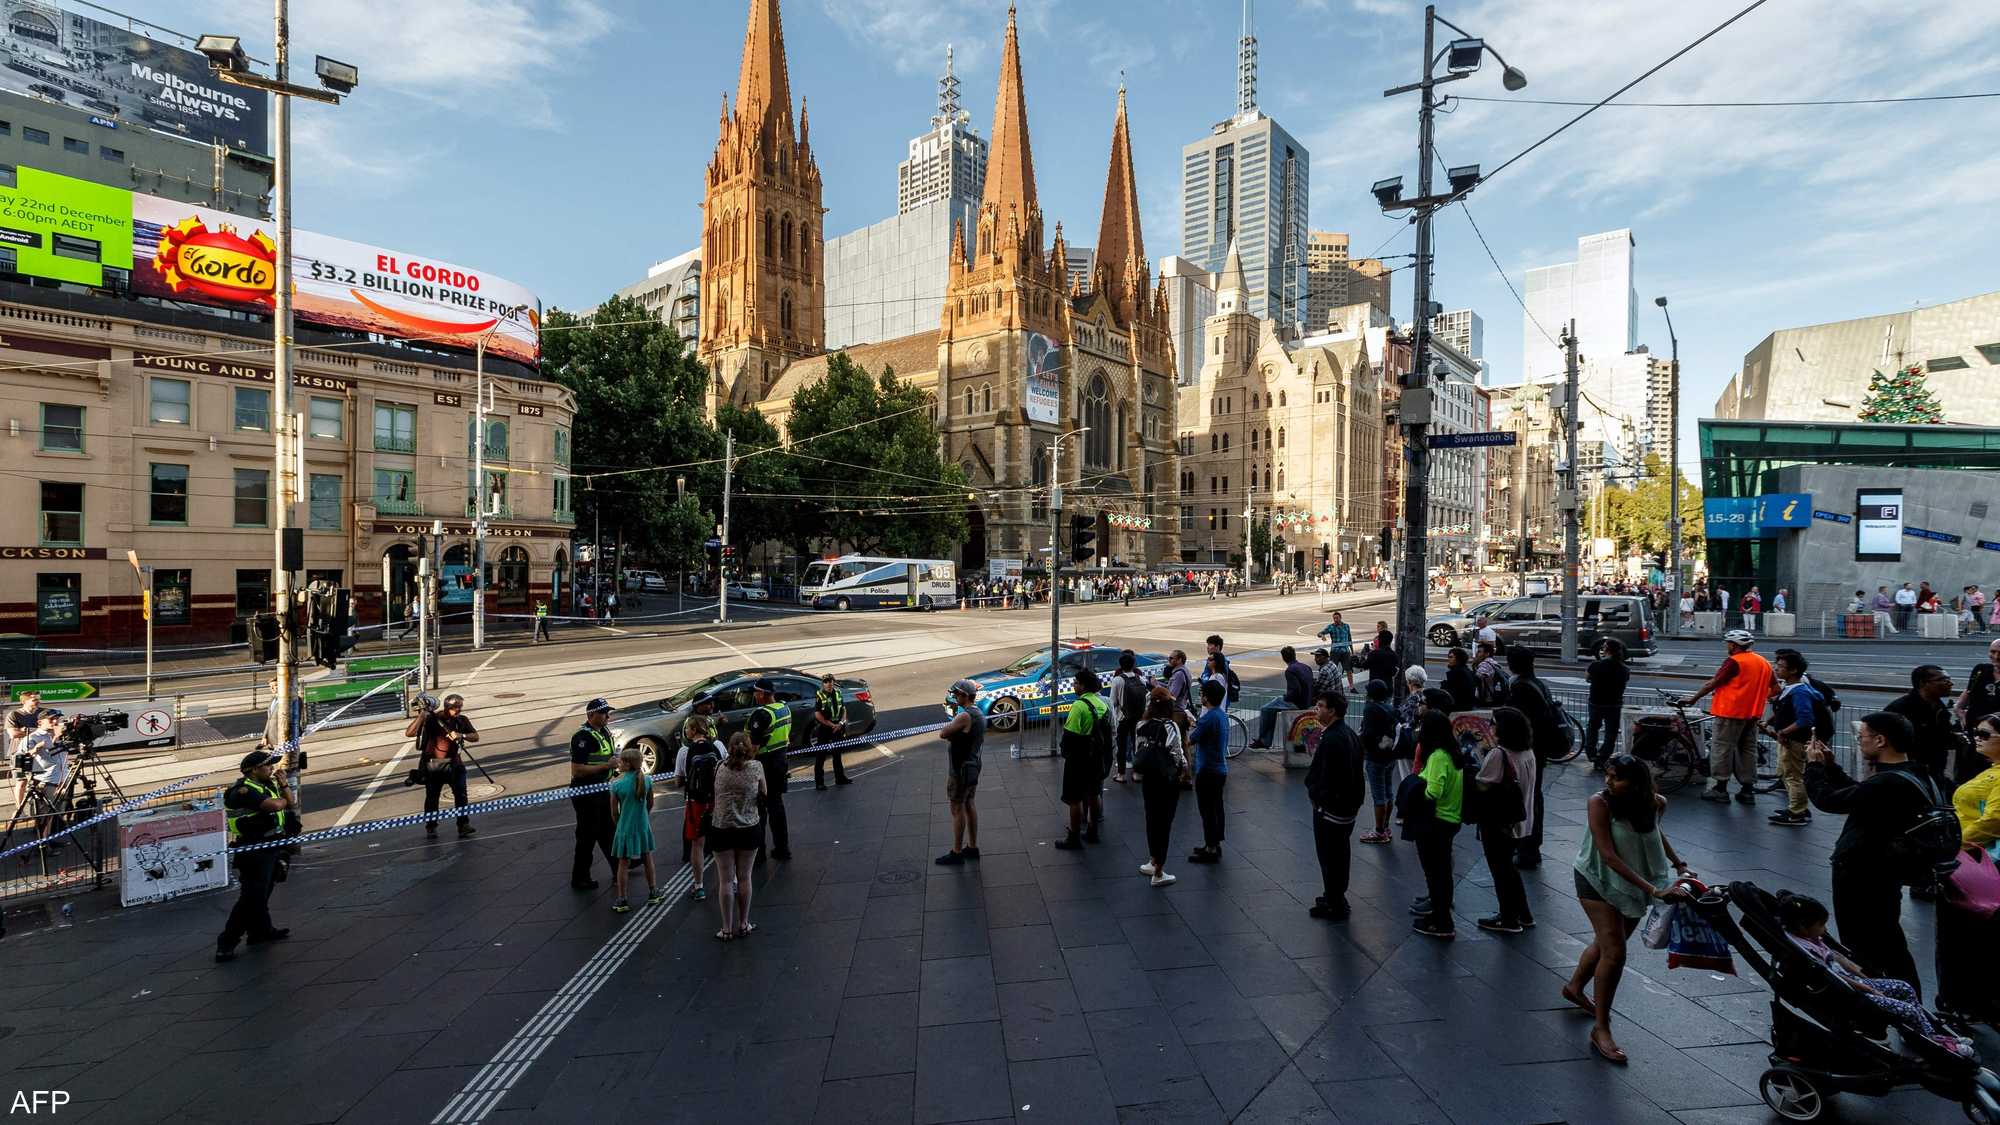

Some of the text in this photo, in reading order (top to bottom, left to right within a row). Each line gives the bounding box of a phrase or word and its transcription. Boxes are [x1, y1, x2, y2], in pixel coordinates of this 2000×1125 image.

[131, 62, 252, 111] Melbourne.
[150, 96, 176, 110] Since
[160, 86, 241, 121] Always.
[92, 117, 115, 128] APN
[0, 194, 126, 227] ay 22nd December
[3, 207, 95, 232] 6:00pm AEDT
[190, 255, 266, 284] Gordo
[377, 254, 480, 291] EL GORDO
[311, 260, 520, 322] $3.2 BILLION PRIZE POOL
[141, 355, 347, 391] YOUNG AND JCKSON
[1031, 386, 1058, 399] WELCOME
[520, 405, 541, 416] 1875
[1454, 432, 1514, 444] Swanston St
[1708, 513, 1745, 523] 15-28
[467, 528, 533, 537] JCKSON
[2, 548, 87, 559] CKSON
[1040, 704, 1073, 714] HIHW
